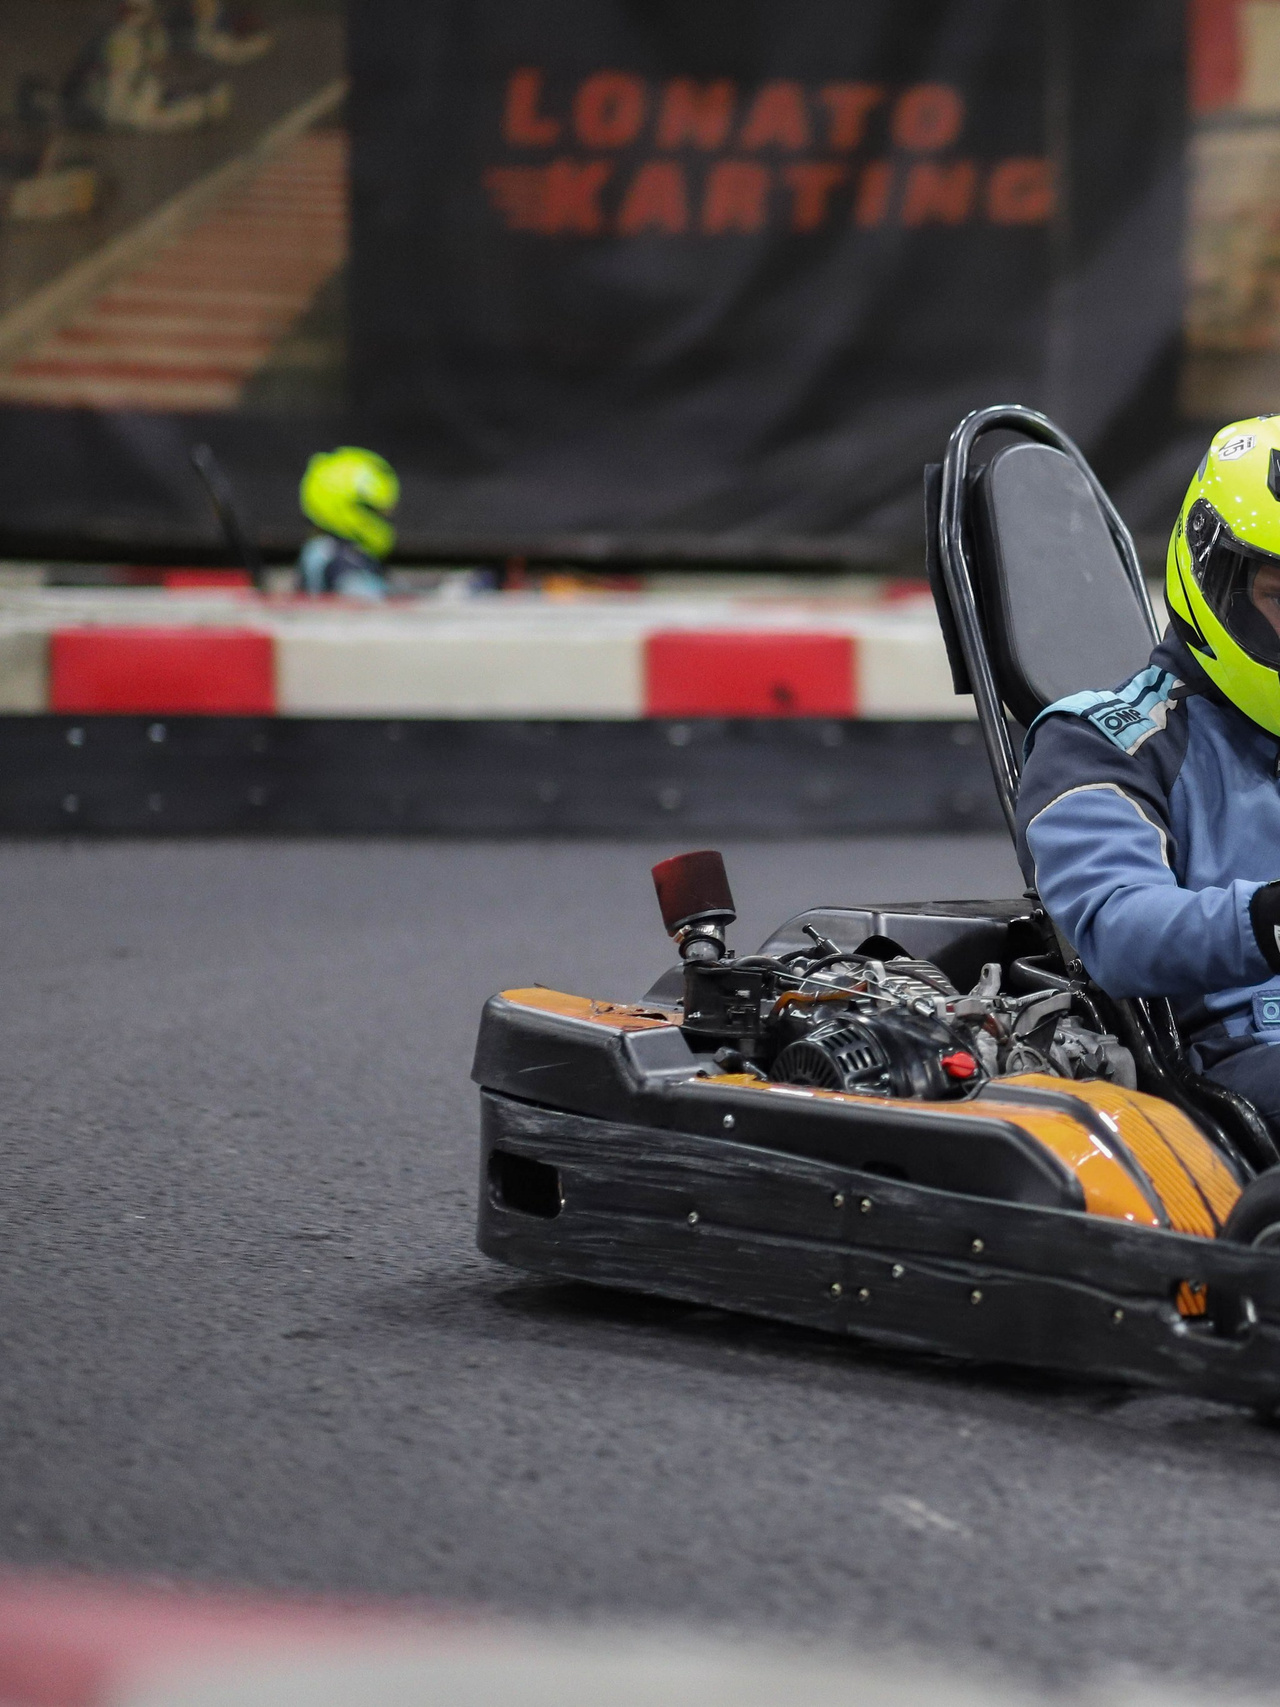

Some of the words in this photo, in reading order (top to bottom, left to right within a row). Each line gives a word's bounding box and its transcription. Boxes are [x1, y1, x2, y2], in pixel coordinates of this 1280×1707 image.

[503, 67, 966, 151] LONATO
[490, 156, 1056, 235] KARTING
[1104, 708, 1142, 730] OMP
